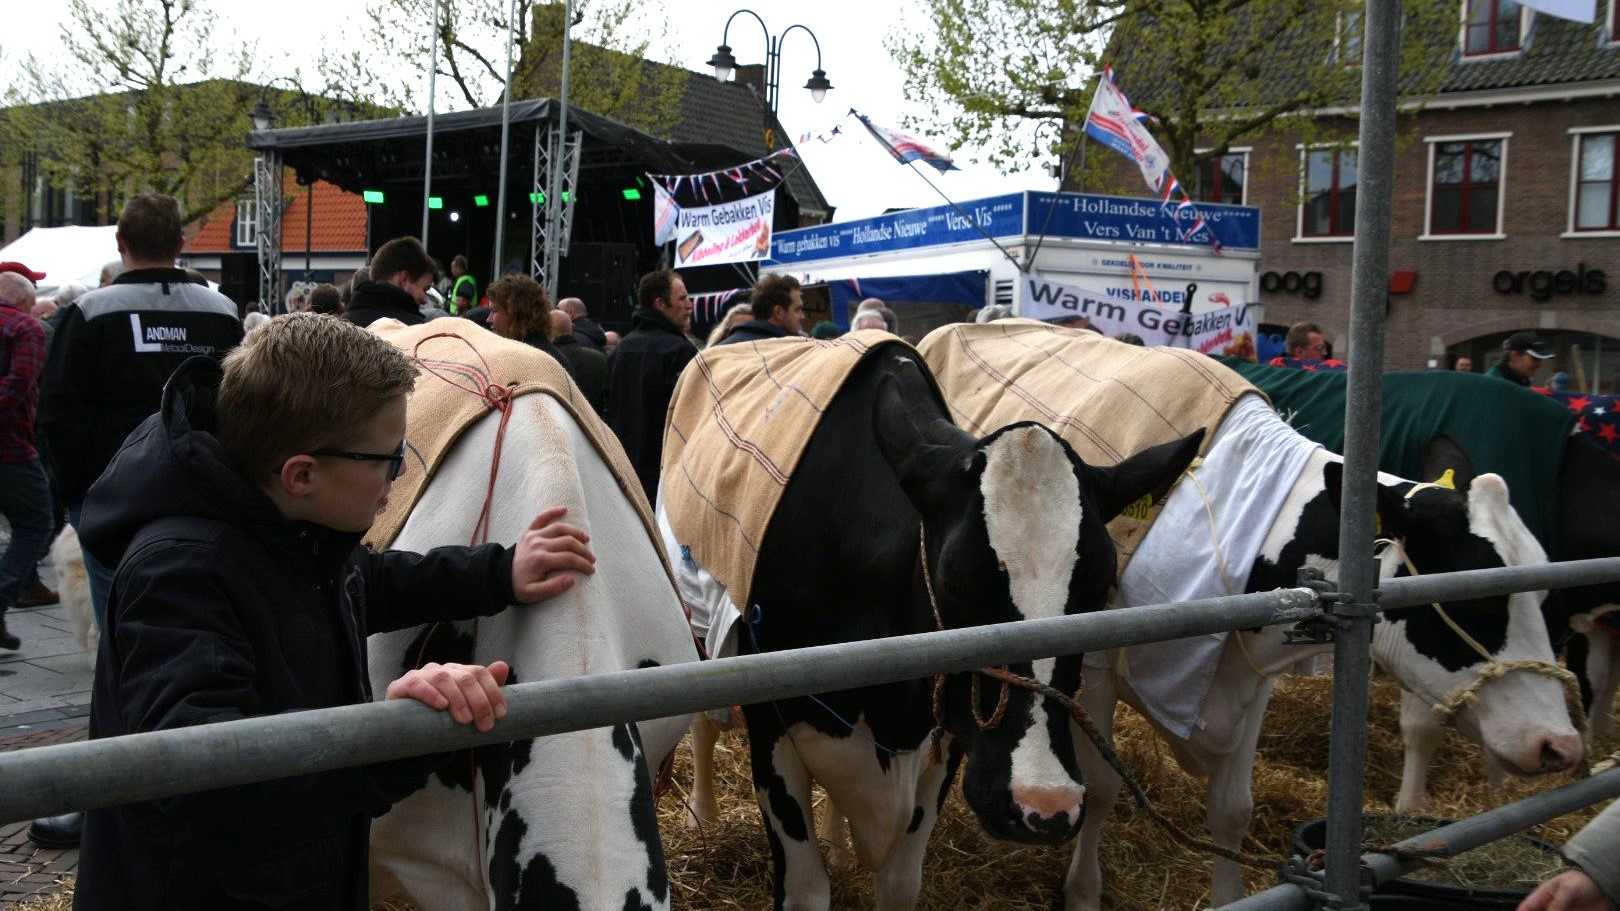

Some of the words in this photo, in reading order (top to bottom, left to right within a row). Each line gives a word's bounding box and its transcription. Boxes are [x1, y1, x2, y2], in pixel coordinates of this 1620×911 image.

[681, 211, 710, 228] Warm
[711, 202, 757, 225] Gebakken
[759, 195, 772, 216] Vis
[1074, 197, 1156, 218] Hollandse
[1160, 205, 1223, 222] Neuwe
[777, 238, 796, 254] Warm
[796, 233, 828, 257] gebakken
[829, 230, 841, 248] vis
[852, 223, 892, 245] Hollandse
[894, 219, 927, 239] Nieuwe
[945, 211, 973, 231] Verse
[975, 206, 993, 227] Vis
[1083, 220, 1120, 238] Vers
[1125, 223, 1156, 240] Van
[1161, 226, 1170, 241] 't
[1493, 262, 1607, 303] orgels
[1028, 279, 1126, 322] Warm
[1137, 307, 1232, 338] Gebakken
